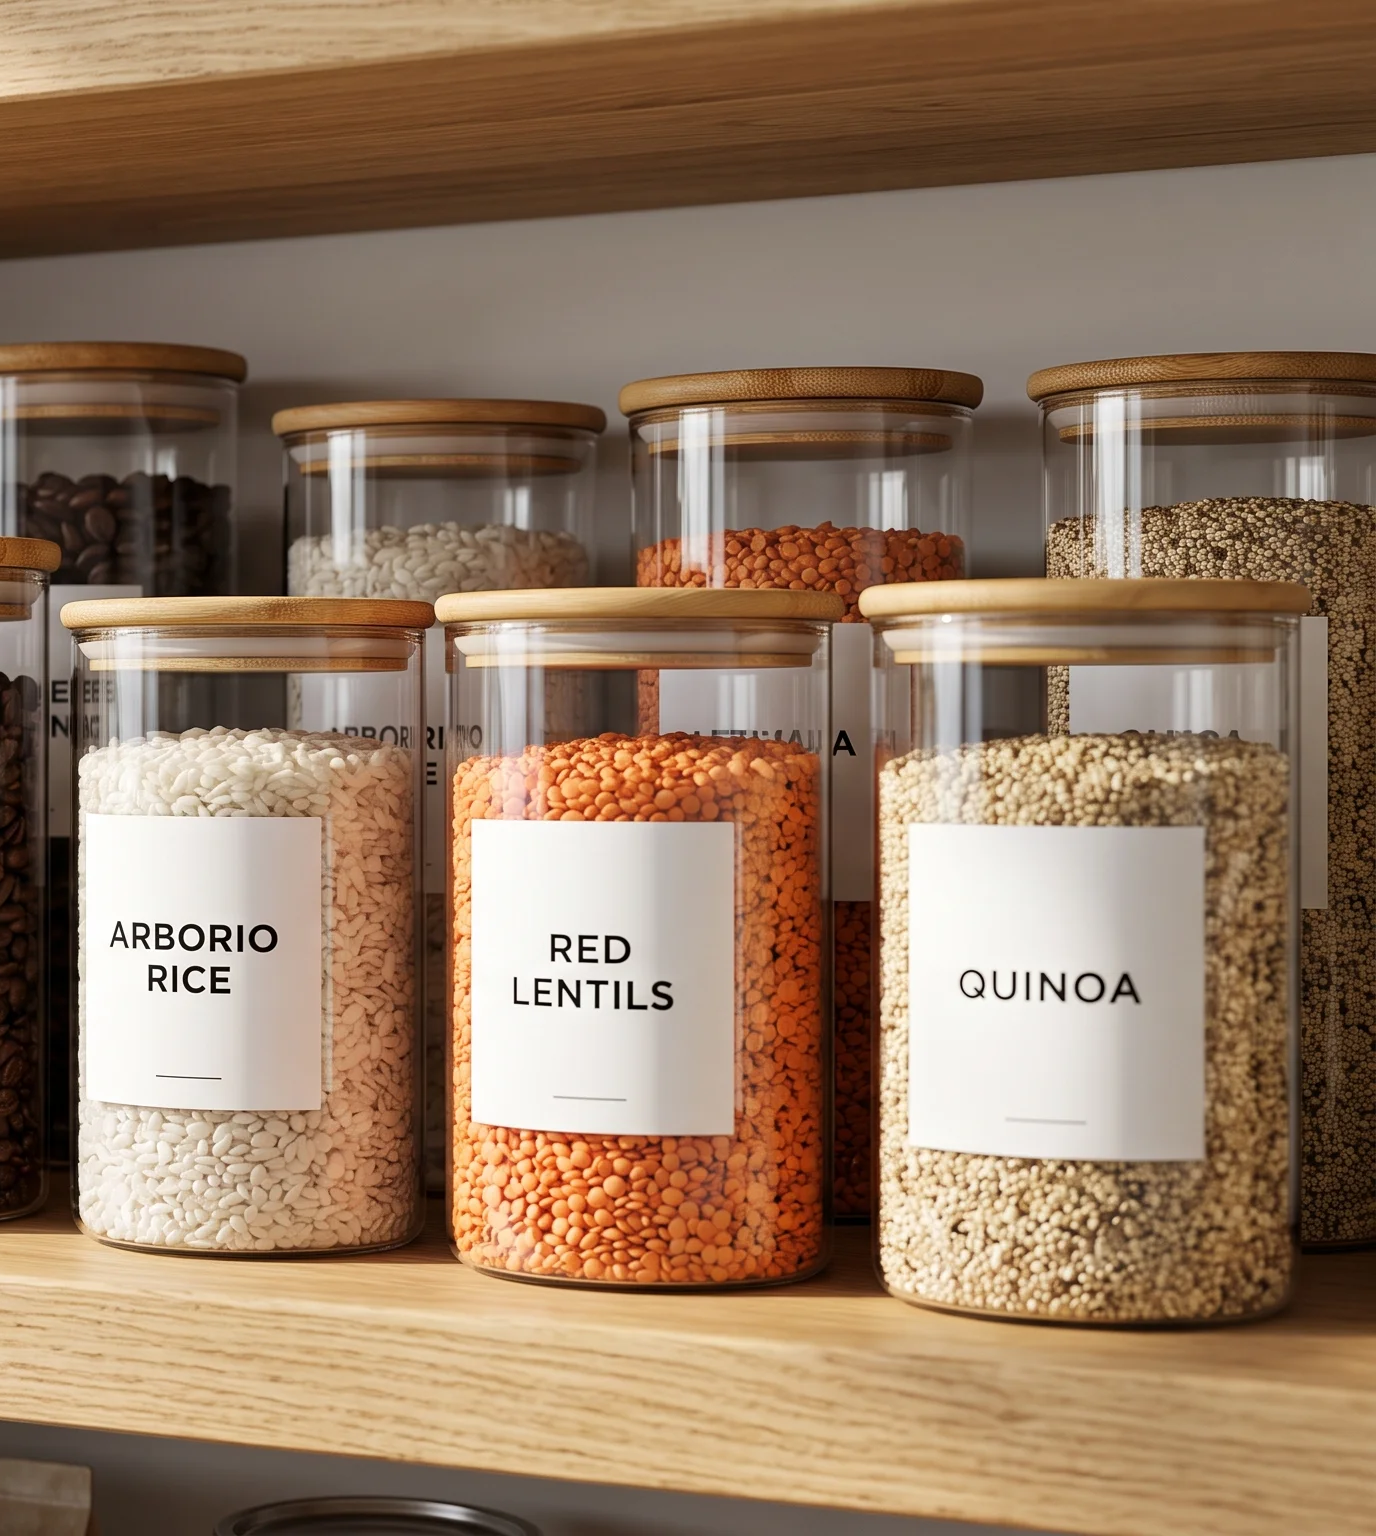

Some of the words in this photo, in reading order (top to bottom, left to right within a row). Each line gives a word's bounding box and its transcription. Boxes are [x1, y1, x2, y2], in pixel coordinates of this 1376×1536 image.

[109, 920, 279, 954] ARBORIO
[550, 933, 632, 965] RED
[147, 963, 232, 995] RICE
[512, 976, 675, 1012] LENTILS
[958, 968, 1142, 1005] QUINOA
